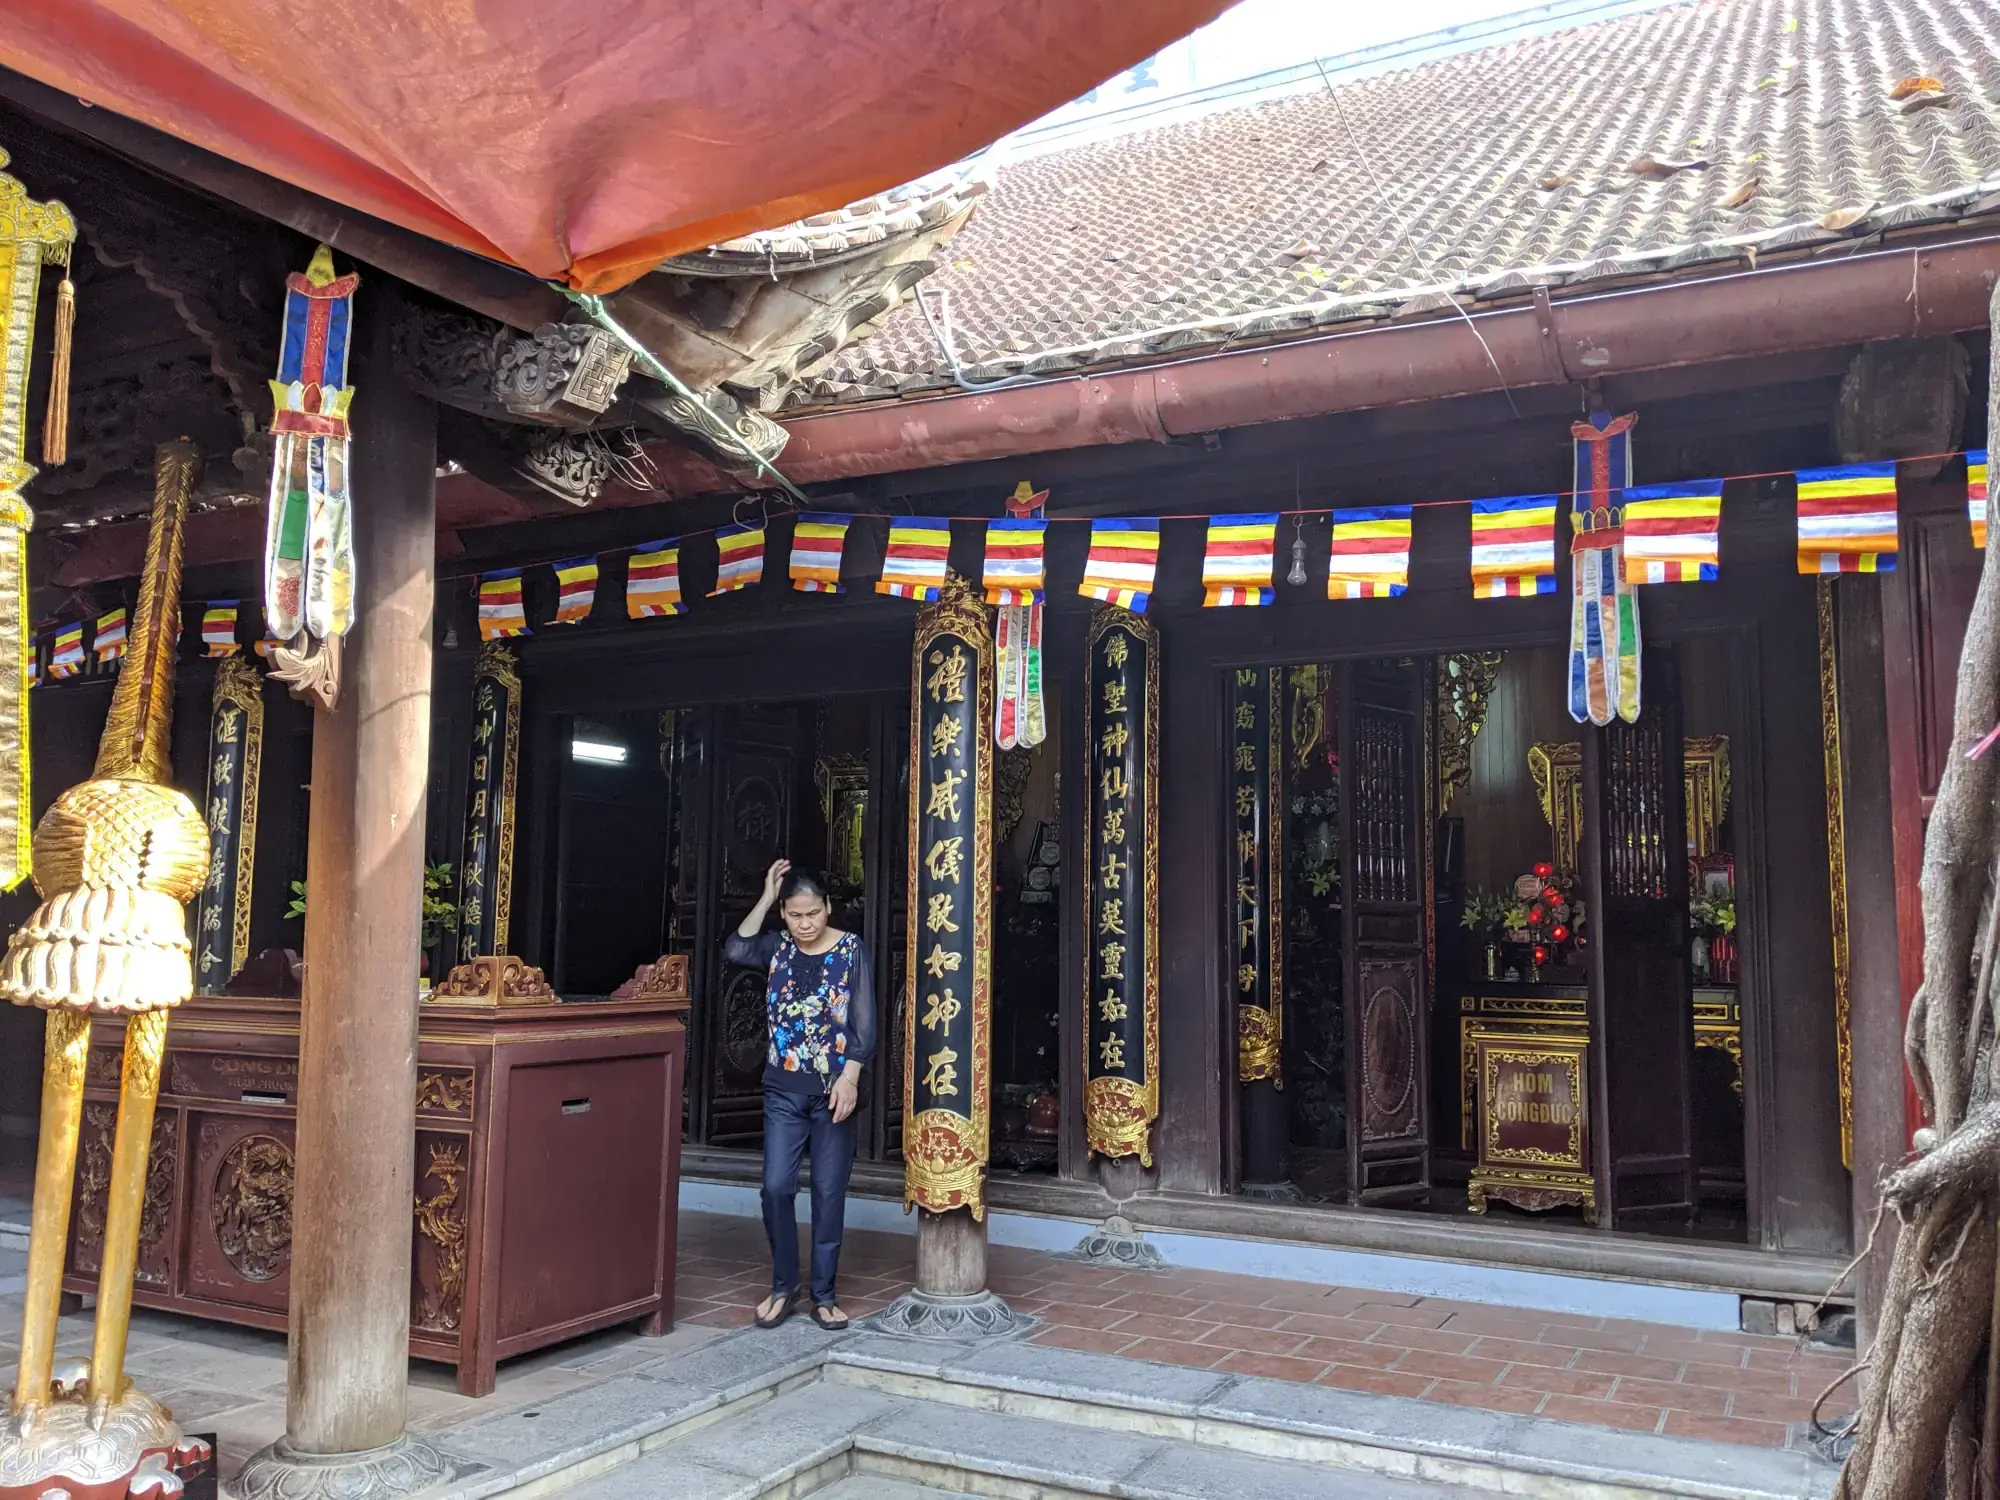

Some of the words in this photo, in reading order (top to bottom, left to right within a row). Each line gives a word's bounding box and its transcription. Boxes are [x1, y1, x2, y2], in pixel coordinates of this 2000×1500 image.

[921, 643, 968, 1098] 禮樂威儀敬如神在
[1512, 1067, 1554, 1094] HÒM
